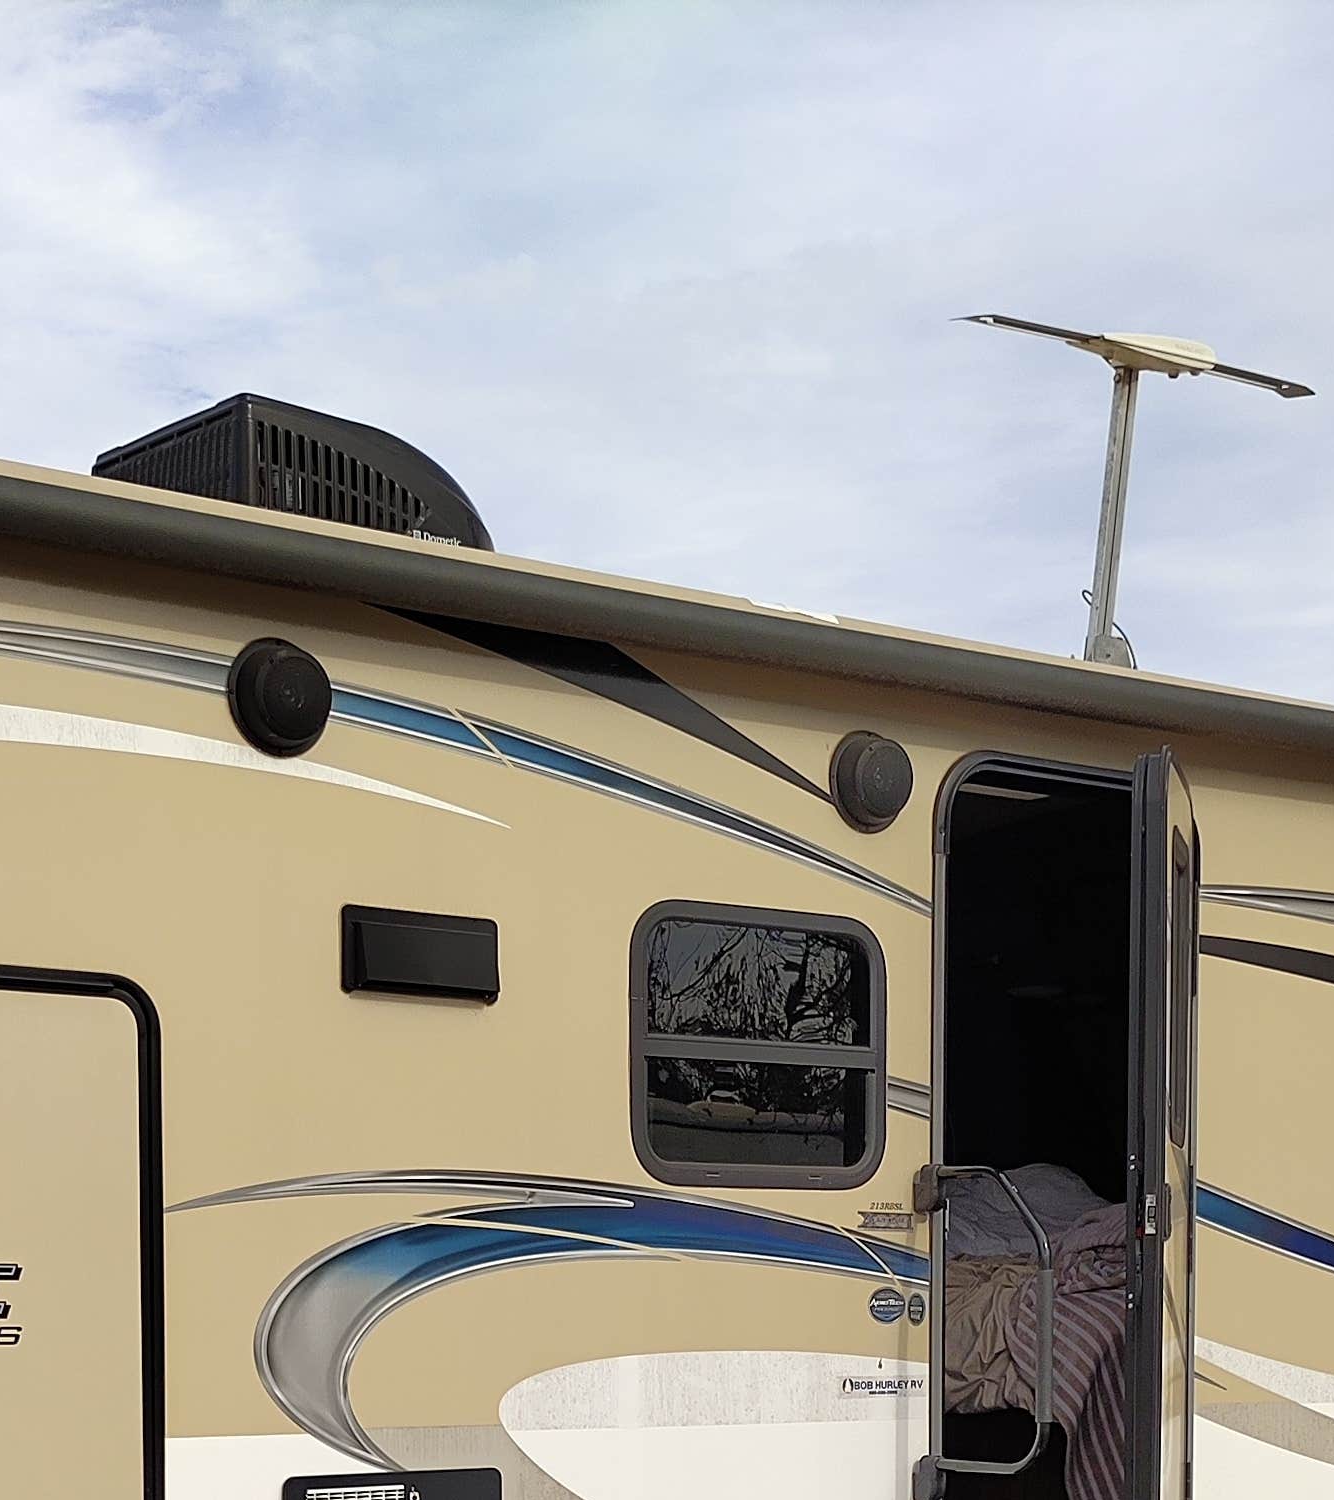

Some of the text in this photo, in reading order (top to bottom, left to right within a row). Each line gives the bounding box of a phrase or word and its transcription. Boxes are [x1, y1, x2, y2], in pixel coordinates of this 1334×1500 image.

[854, 1379, 924, 1390] BOB HURLEY RV
